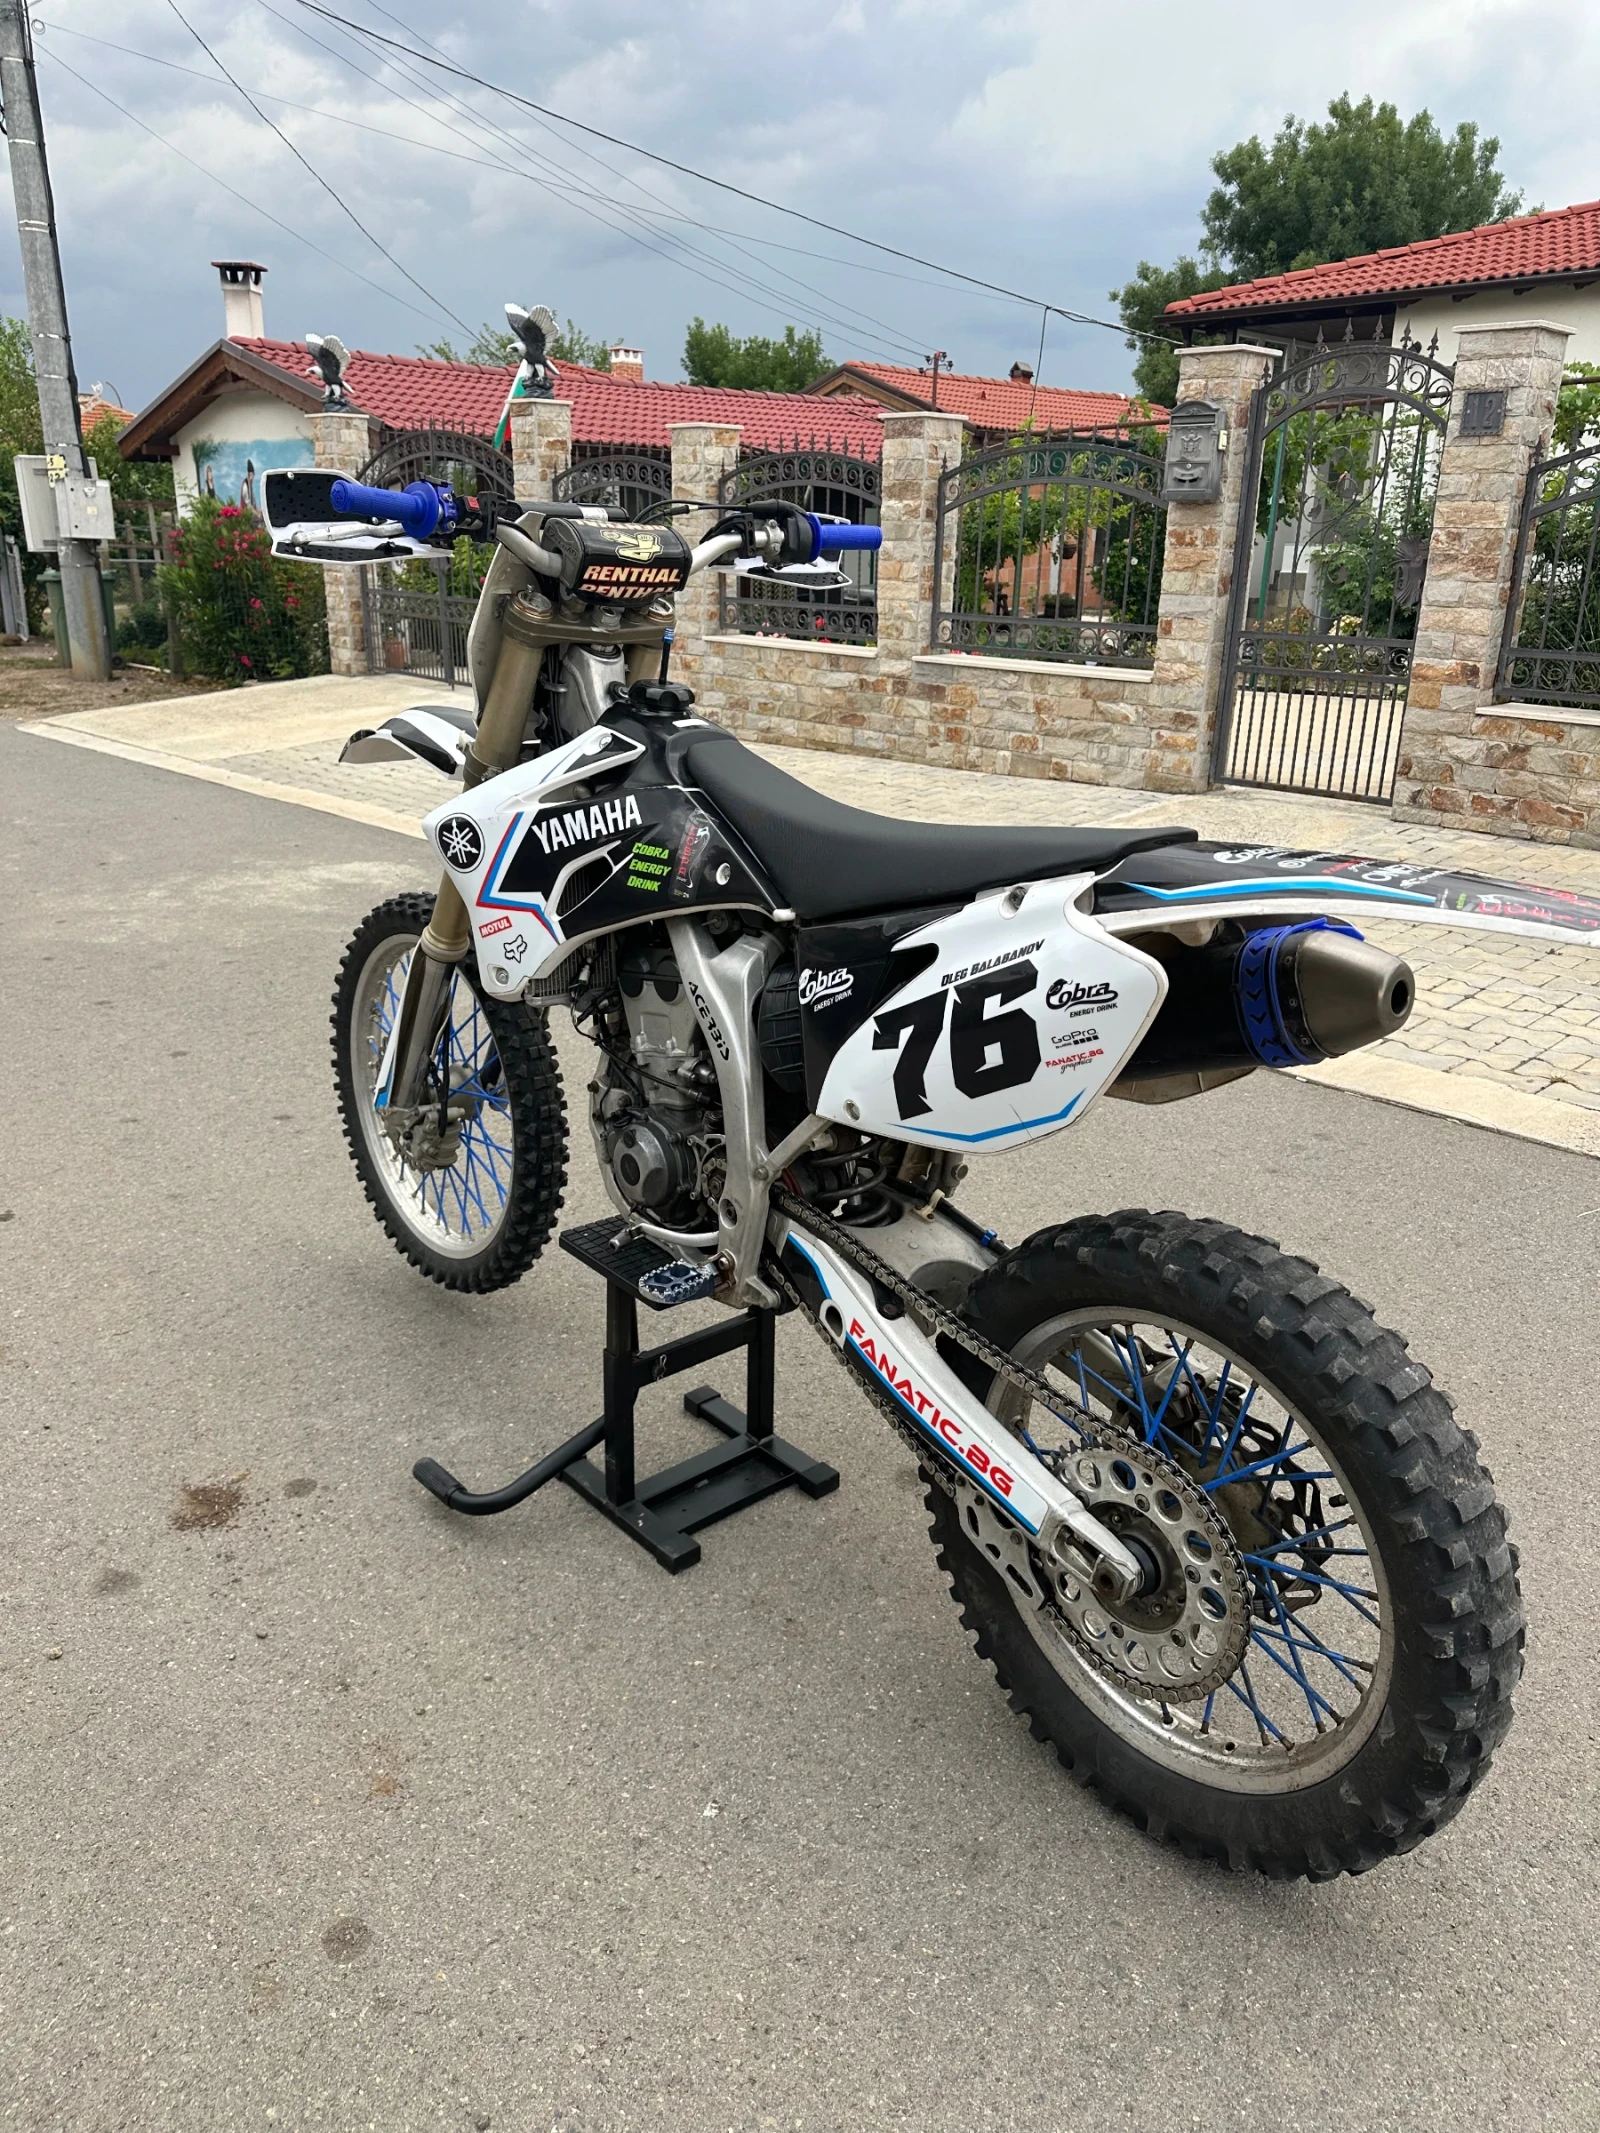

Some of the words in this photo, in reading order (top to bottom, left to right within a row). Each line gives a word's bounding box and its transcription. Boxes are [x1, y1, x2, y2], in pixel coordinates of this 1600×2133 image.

[1471, 396, 1497, 427] 12
[583, 566, 681, 583] RENTHAL
[531, 794, 643, 854] YAMAHA
[632, 842, 669, 859] COBRA
[629, 859, 672, 876] ENERGY
[627, 875, 661, 891] DRINK
[480, 918, 510, 936] MOTUL
[941, 968, 969, 987] OLEG
[970, 938, 1046, 976] BALABANOV
[798, 968, 854, 1005] Cobra
[1046, 978, 1119, 1012] Cobra
[814, 996, 834, 1012] ENERGY
[834, 988, 853, 1003] DRINK
[1069, 1007, 1095, 1018] ENERGY
[1096, 1002, 1118, 1013] DRINK
[872, 958, 1042, 1121] 76
[1051, 1028, 1098, 1044] GoPro
[1045, 1048, 1104, 1068] FANATIC.BG
[849, 1317, 1015, 1498] FANATIC.BG
